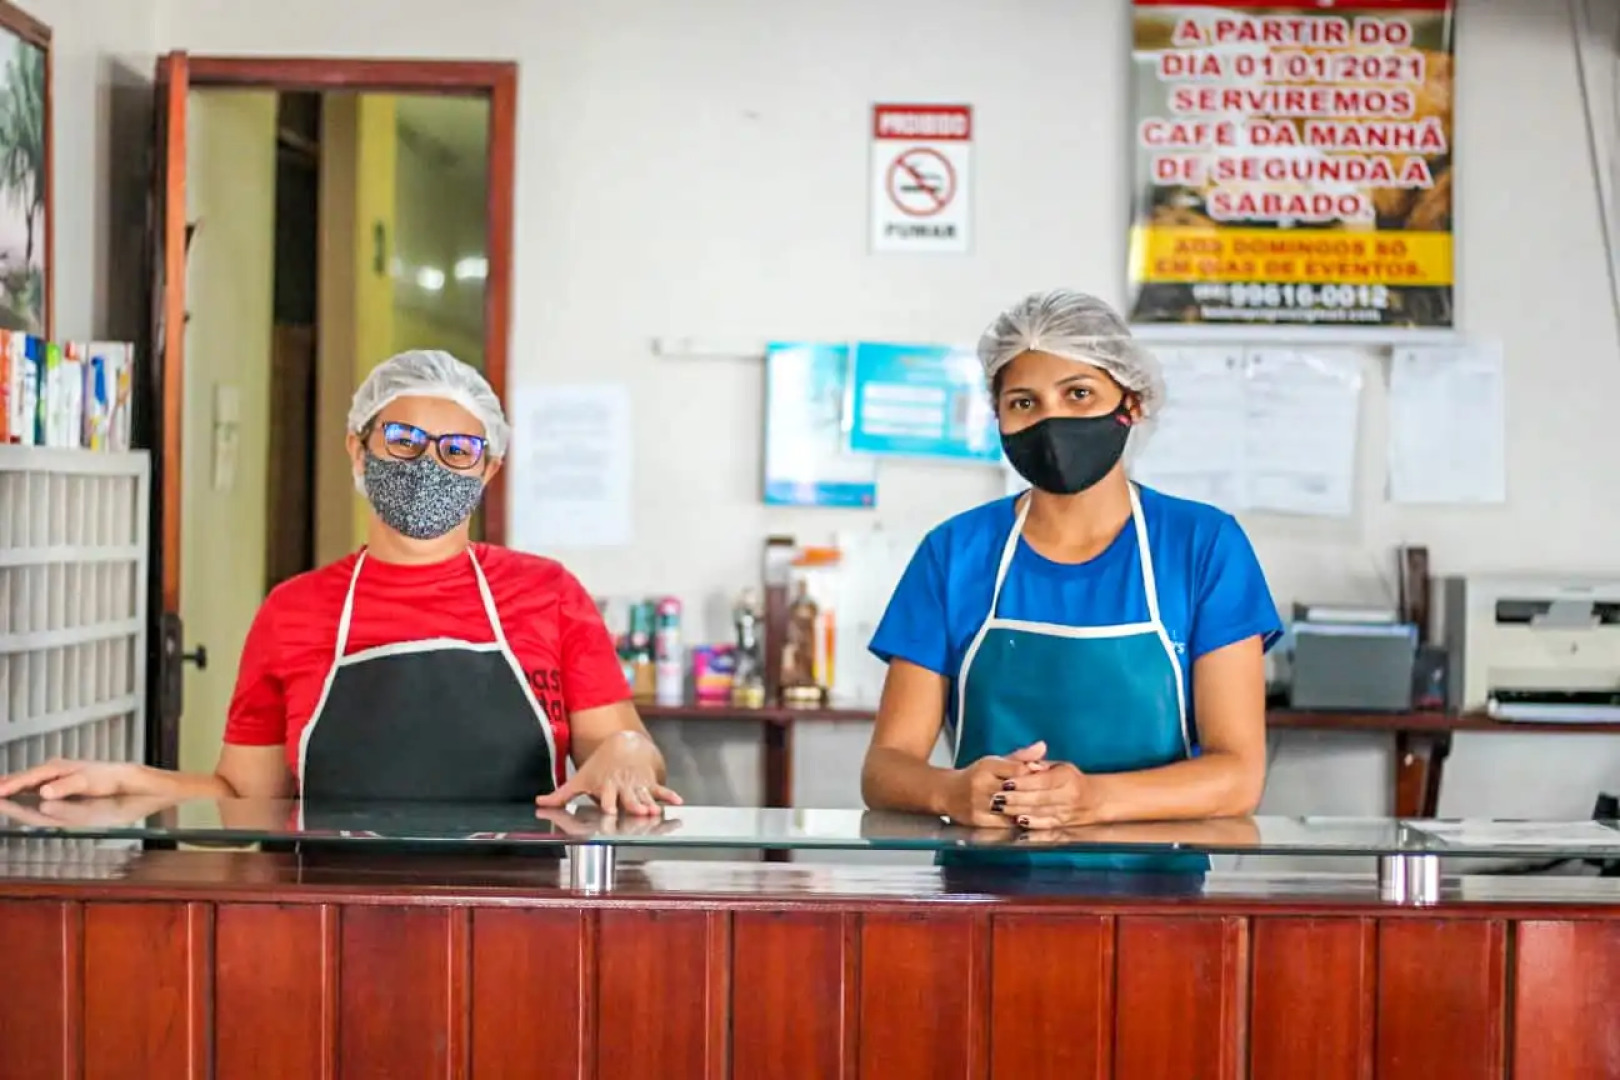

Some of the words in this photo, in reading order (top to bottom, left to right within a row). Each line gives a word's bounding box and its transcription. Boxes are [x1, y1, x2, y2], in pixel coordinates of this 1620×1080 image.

[1180, 19, 1201, 41] A
[1215, 19, 1345, 44] PARTIR
[1360, 21, 1408, 44] DO
[1162, 54, 1221, 77] DIA
[1175, 88, 1412, 114] SERVIREMOS
[1143, 119, 1236, 146] CAFÉ
[1250, 124, 1296, 146] DA
[1157, 158, 1199, 181] DE
[1217, 158, 1394, 181] SEGUNDA
[1405, 161, 1429, 182] A
[885, 223, 957, 238] FUMAR
[1232, 238, 1365, 256] DOMINGOS
